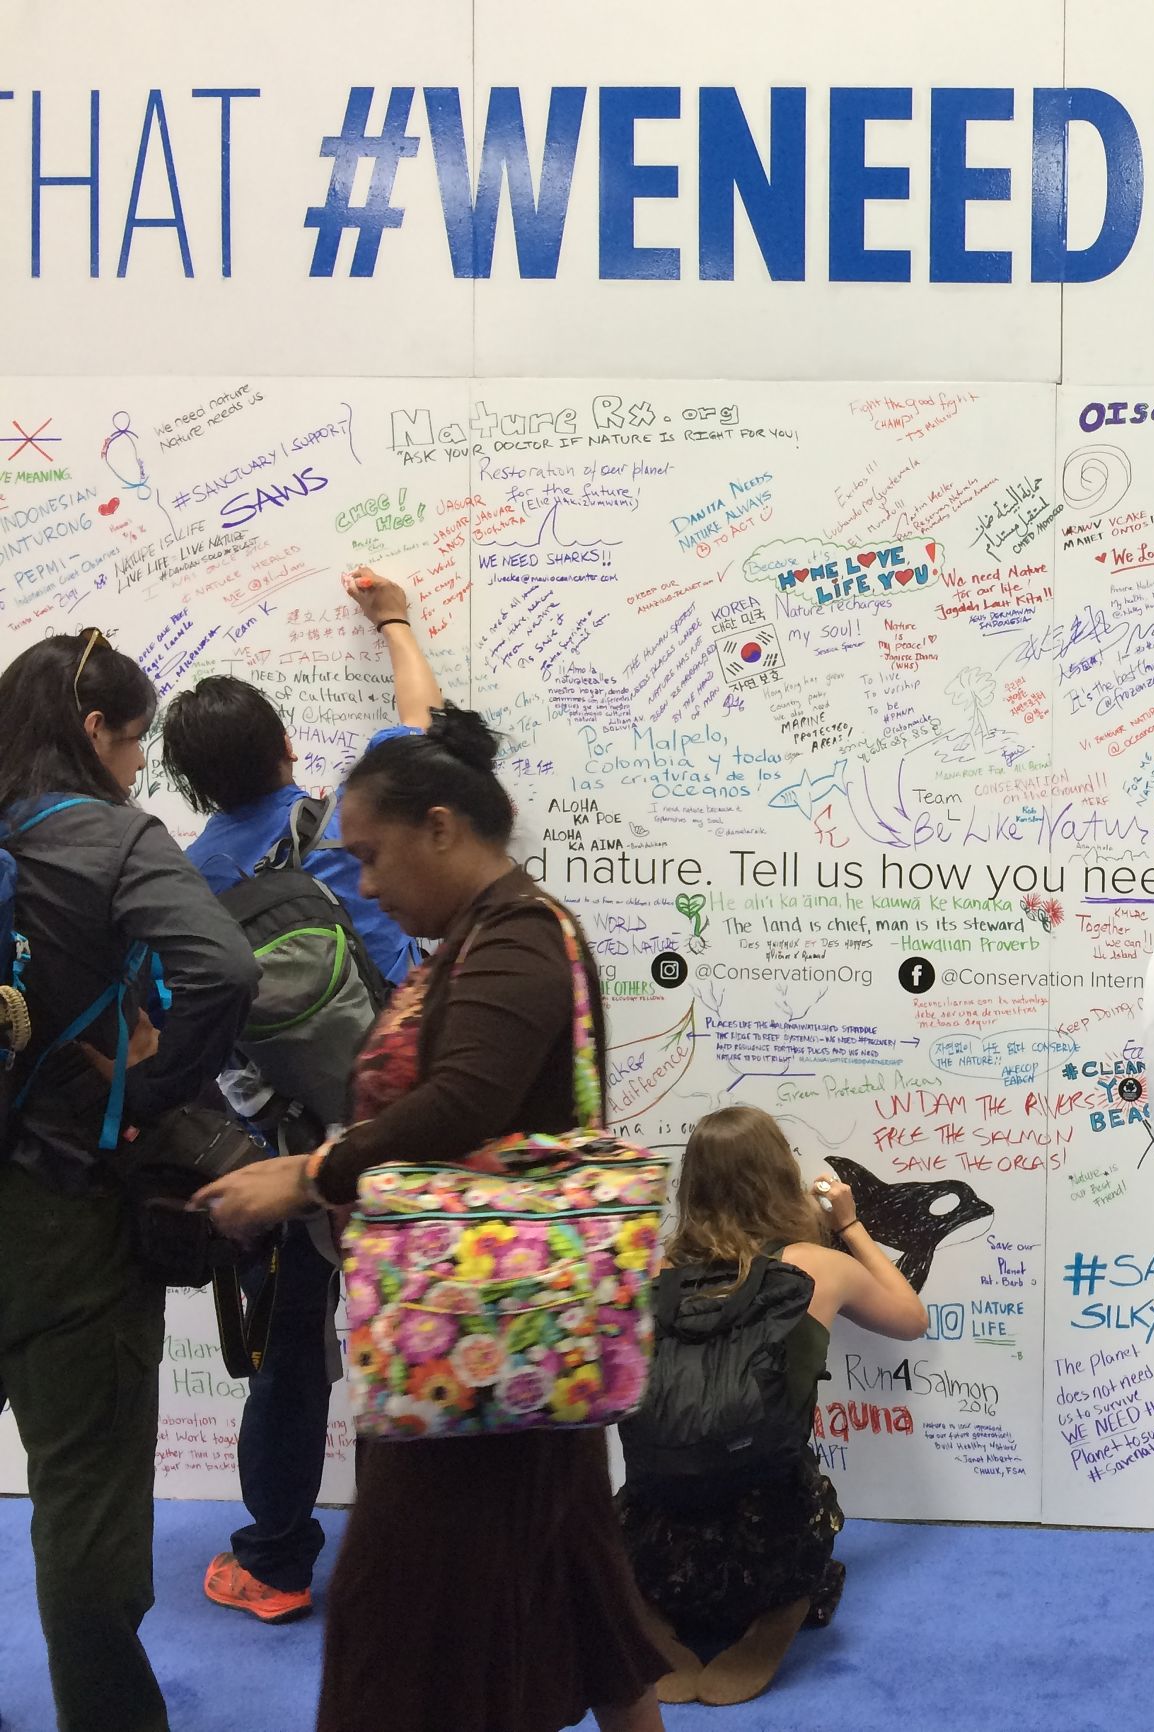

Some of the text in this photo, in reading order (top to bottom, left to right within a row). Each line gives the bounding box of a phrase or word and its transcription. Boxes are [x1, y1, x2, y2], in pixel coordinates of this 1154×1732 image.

[0, 88, 260, 279] HAT
[173, 384, 251, 434] need nature
[159, 391, 264, 453] Nature needs us
[391, 401, 577, 450] Nature
[445, 428, 766, 460] YOUR DOCTOR IF NATURE RIGHT FOR
[172, 419, 348, 510] #SANCTUARY SUPPORT
[479, 457, 575, 481] Restoration
[220, 467, 328, 529] SAWS
[542, 483, 575, 498] the
[670, 471, 773, 537] DANITA NEEDS
[678, 490, 772, 553] NATURE ALWAYS
[730, 518, 757, 540] ACT
[479, 554, 538, 570] WE NEED
[747, 556, 799, 577] Because
[1112, 548, 1135, 564] We
[941, 563, 1049, 591] We need Nature
[711, 596, 760, 621] KOREA
[775, 593, 893, 620] Nature recharges
[223, 615, 259, 643] Team
[712, 617, 739, 635] 대한
[578, 725, 614, 756] Por
[732, 747, 782, 766] todas
[571, 766, 782, 792] las criaturas de los
[548, 798, 599, 813] ALOHA
[912, 788, 963, 805] Team
[573, 812, 622, 825] KA POE
[543, 828, 583, 841] ALOHA
[569, 839, 624, 851] KA AINA
[567, 851, 712, 886] nature.
[730, 851, 798, 886] Tell
[818, 860, 863, 888] us
[882, 854, 971, 890] how
[988, 860, 1064, 900] you
[780, 893, 797, 908] ka
[846, 895, 864, 910] he
[930, 895, 947, 910] ke
[952, 895, 1012, 911] kanaka
[723, 917, 752, 935] The
[763, 916, 802, 933] land
[810, 919, 822, 932] is
[876, 920, 909, 933] man
[916, 919, 928, 932] is
[936, 918, 957, 931] its
[964, 918, 1024, 933] steward
[980, 937, 1040, 952] Proverb
[695, 963, 873, 986] @ConservationOrg
[941, 968, 1144, 990] @Conservation Intern
[614, 980, 655, 996] OTHERS
[976, 1091, 1096, 1121] THE RIVERS
[873, 1124, 1074, 1152] FREE THE SALMON
[892, 1152, 992, 1173] SAVE THE
[971, 1301, 1024, 1316] NATURE
[973, 1320, 1009, 1337] LIFE
[1055, 1358, 1085, 1377] The
[1057, 1365, 1154, 1406] does not need
[959, 1400, 996, 1416] 2016
[1062, 1427, 1088, 1446] WE
[1096, 1406, 1140, 1437] NEED
[1070, 1438, 1122, 1470] Planet
